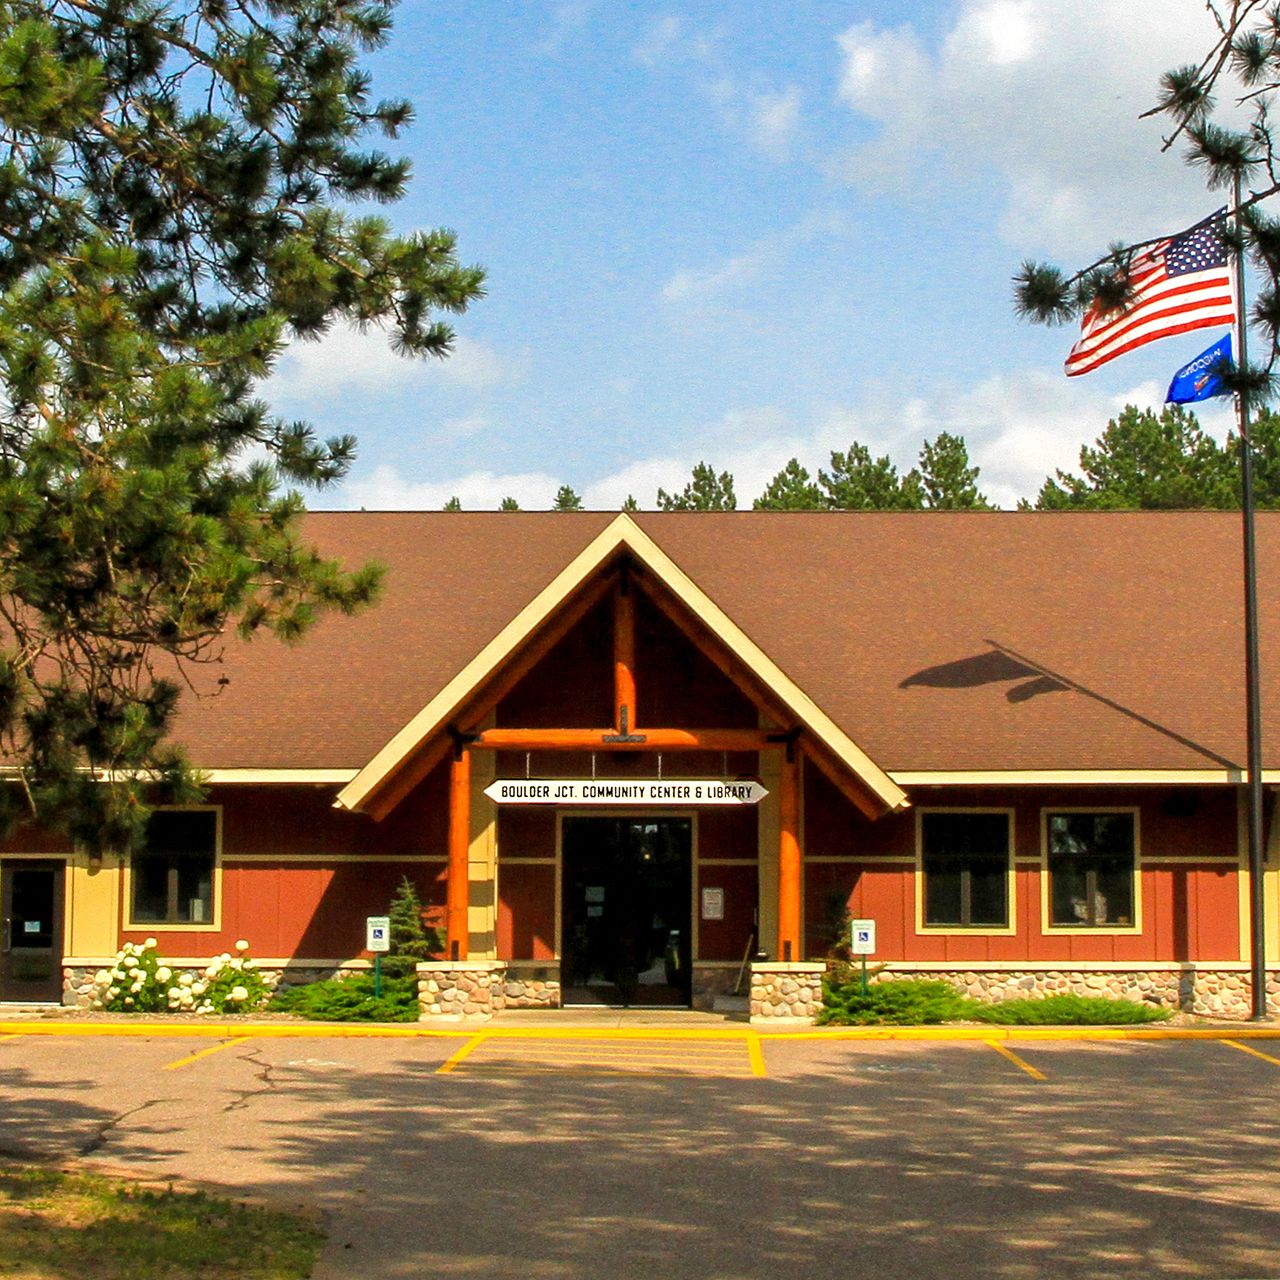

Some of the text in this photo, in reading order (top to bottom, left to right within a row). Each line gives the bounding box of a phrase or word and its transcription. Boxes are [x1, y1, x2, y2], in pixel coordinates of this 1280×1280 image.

[501, 785, 753, 798] BOULDER JCT. COMMUNITY CENTER & LIBRARY
